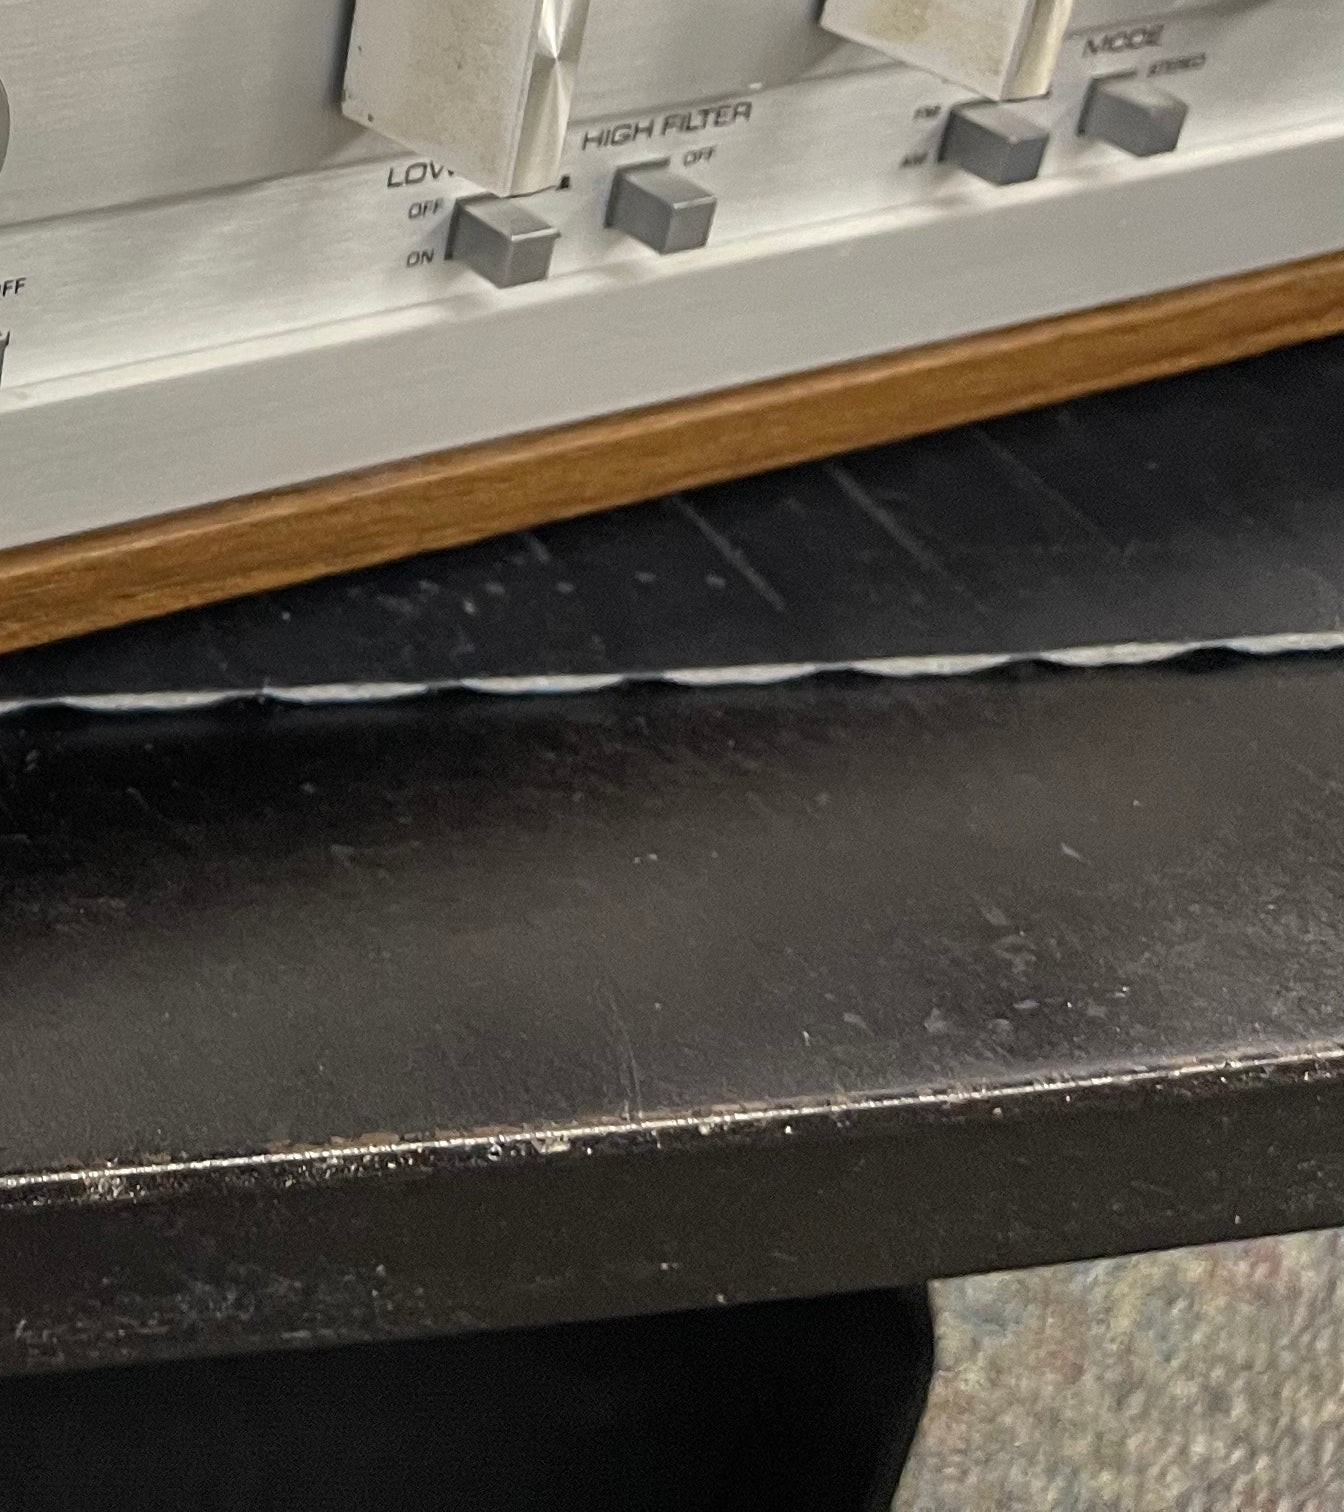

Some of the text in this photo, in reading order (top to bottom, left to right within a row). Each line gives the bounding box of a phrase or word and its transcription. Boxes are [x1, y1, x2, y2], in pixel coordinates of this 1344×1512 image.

[581, 118, 655, 151] HIGH
[657, 97, 753, 136] FILTER
[683, 145, 718, 168] OFF
[407, 197, 446, 221] OFF
[406, 249, 435, 266] ON
